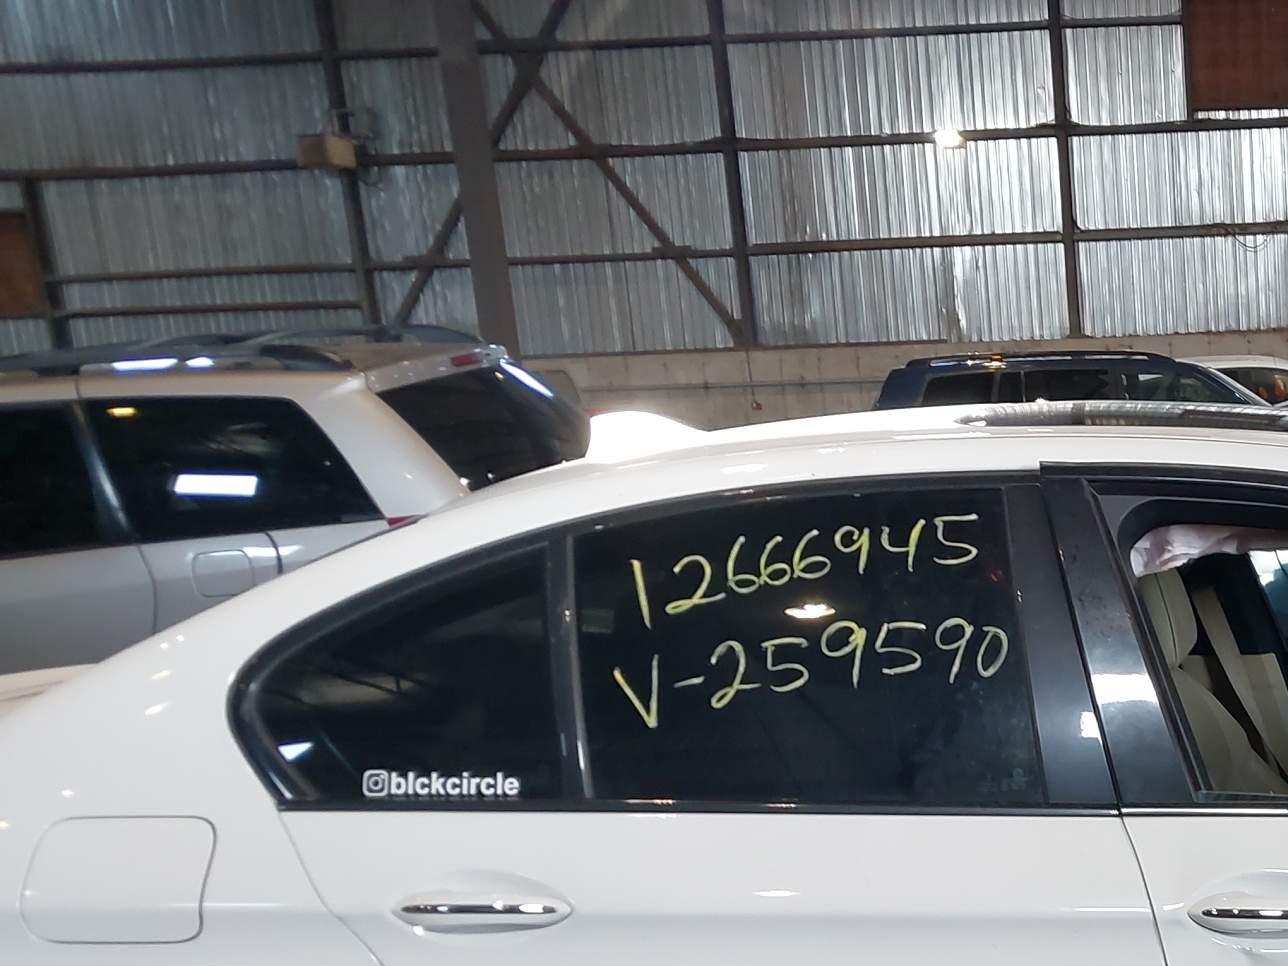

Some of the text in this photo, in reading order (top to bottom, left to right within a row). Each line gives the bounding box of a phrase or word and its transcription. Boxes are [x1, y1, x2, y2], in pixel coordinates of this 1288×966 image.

[629, 512, 979, 630] 12666945
[612, 616, 1010, 730] V-259590
[390, 771, 520, 796] blckcircle
